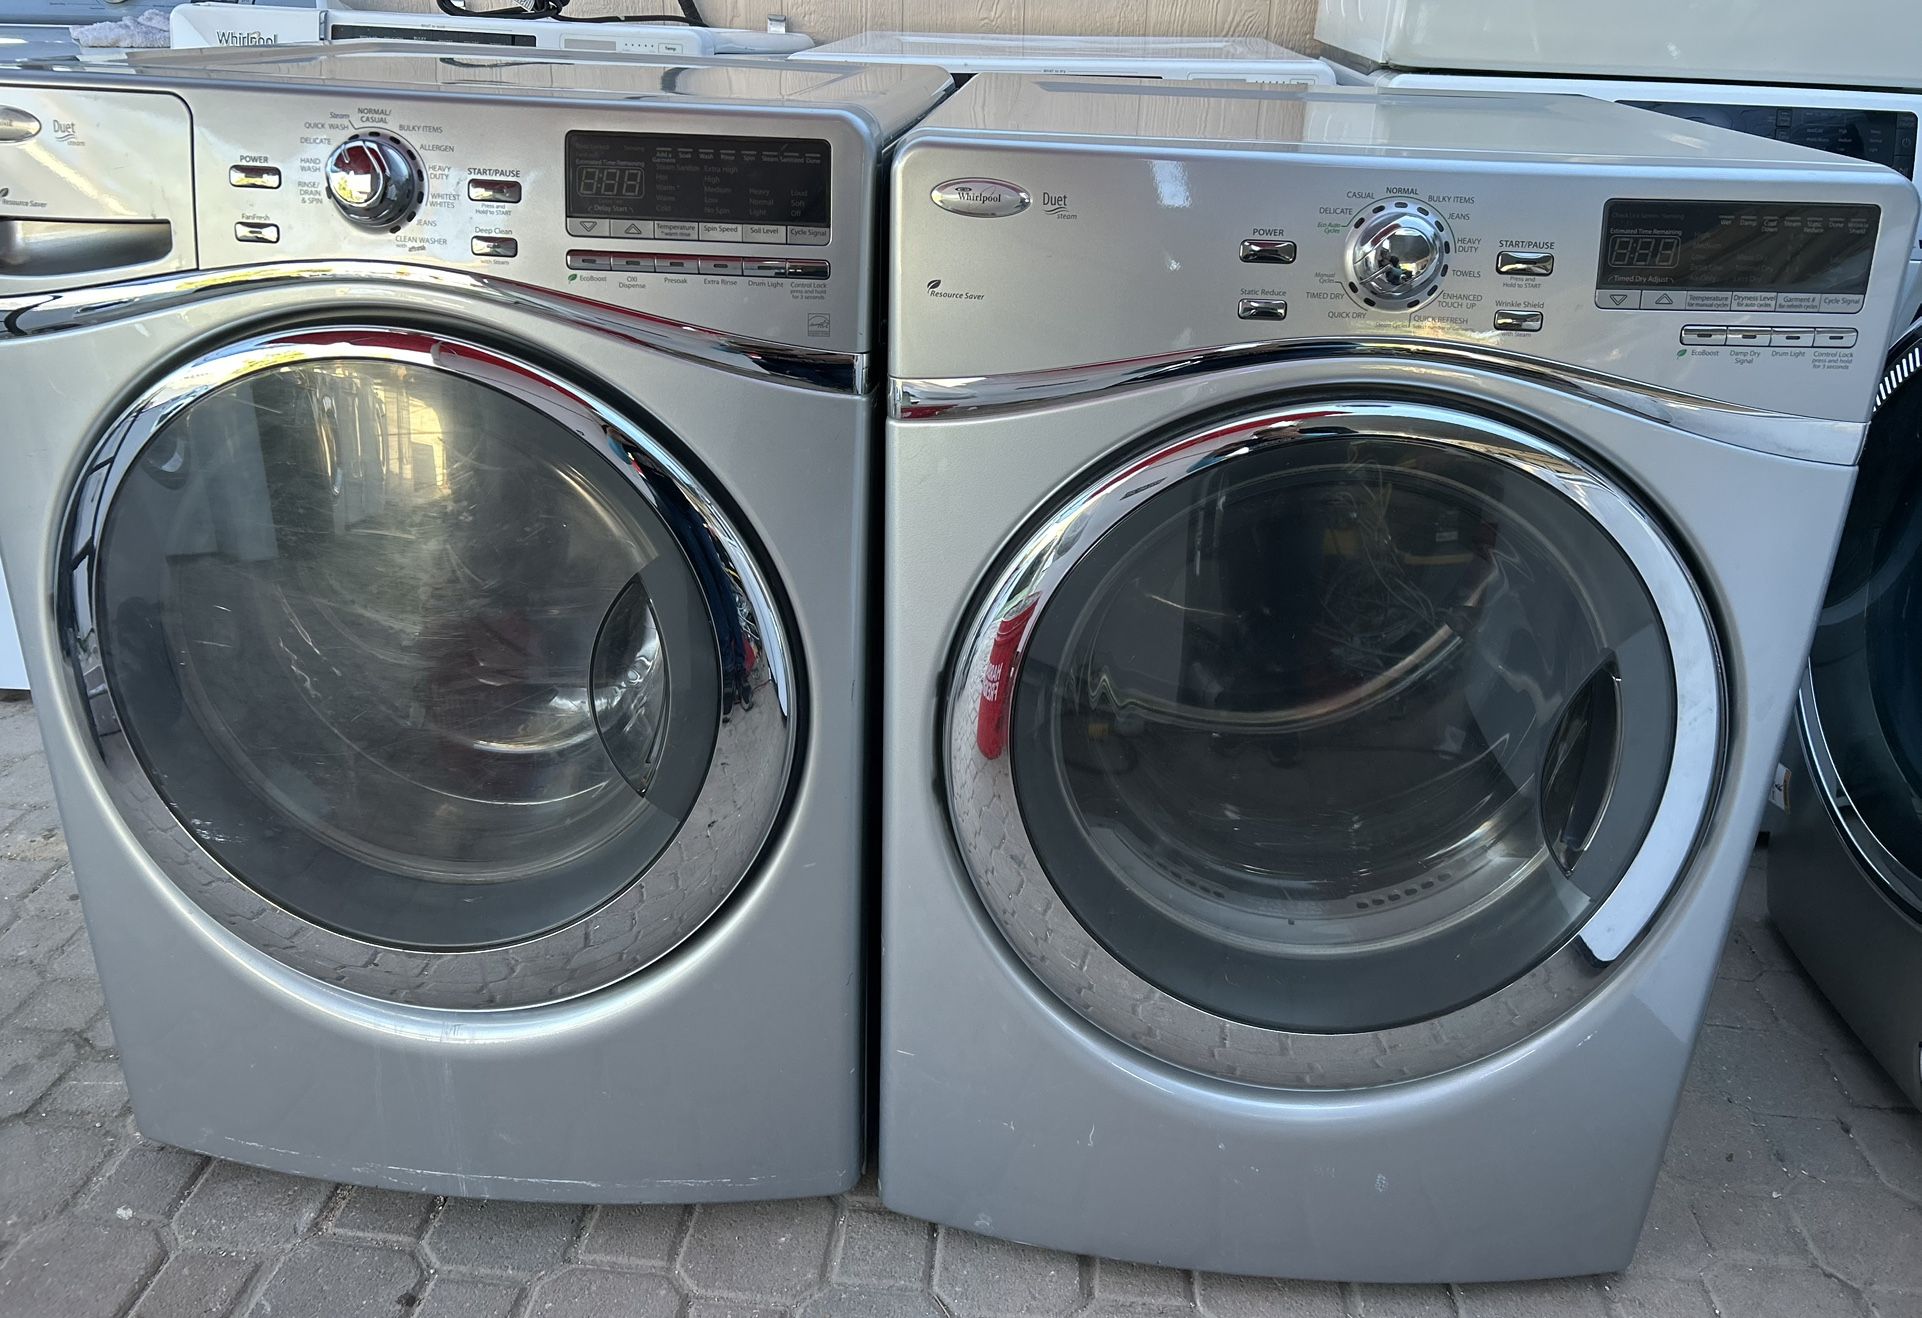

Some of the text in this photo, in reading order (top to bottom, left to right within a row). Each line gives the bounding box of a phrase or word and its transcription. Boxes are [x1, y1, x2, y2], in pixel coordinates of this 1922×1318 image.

[216, 31, 277, 46] Whirlpool
[358, 108, 392, 116] NORMAL/
[360, 116, 388, 124] CASUAL
[53, 119, 76, 134] Duet
[304, 122, 326, 130] QUICK
[399, 124, 443, 134] BULKY ITEMS
[300, 137, 332, 145] DELICATE
[420, 143, 455, 153] ALLERGEN
[239, 154, 269, 164] POWER
[300, 165, 321, 173] WASH
[428, 164, 452, 173] HEAVY
[467, 167, 521, 178] START/PAUSE
[430, 173, 450, 181] DUTY
[299, 188, 321, 197] DRAIN
[1346, 191, 1375, 200] CASUAL
[1385, 186, 1419, 196] NORMAL
[308, 197, 324, 205] SPIN
[431, 192, 461, 201] WHITEST
[957, 192, 1002, 204] Whirlpool
[1042, 191, 1068, 207] Duet
[1427, 195, 1475, 204] BULKY ITEMS
[30, 200, 47, 208] Saver
[429, 201, 456, 209] WHITES
[1319, 207, 1353, 216] DELICATE
[1447, 212, 1470, 221] JEANS
[416, 219, 438, 227] JEANS
[656, 223, 696, 232] Temperature
[474, 226, 513, 235] Deep Clean
[703, 225, 738, 235] Spin Speed
[763, 227, 779, 235] Level
[790, 229, 827, 239] Cycle Signal
[1252, 228, 1285, 237] POWER
[395, 235, 448, 246] CLEAN WASHER
[1456, 238, 1482, 246] HEAVY
[1498, 239, 1555, 250] START/PAUSE
[1457, 246, 1479, 254] DUTY
[579, 274, 607, 283] EcoBoost
[1452, 269, 1481, 279] TOWELS
[664, 276, 688, 284] Presoak
[1635, 275, 1647, 284] Dry
[619, 282, 647, 290] Dispense
[768, 280, 784, 289] Light
[790, 281, 827, 290] Control Lock
[930, 289, 985, 301] Resource Saver
[1240, 288, 1287, 297] Static Reduce
[1305, 291, 1345, 300] TIMED DRY
[1442, 292, 1483, 302] ENHANCED
[1688, 294, 1729, 303] Temperature
[1733, 294, 1777, 303] Dryness Level
[1783, 296, 1810, 304] Garment
[1823, 296, 1861, 306] Cycle Signal
[1437, 301, 1477, 310] TOUCH UP
[1495, 300, 1545, 309] Wrinkle Shield
[1327, 310, 1367, 320] QUICK DRY
[1413, 315, 1469, 325] QUICK REFRESH
[1690, 349, 1720, 357] EcoBoost
[1729, 350, 1761, 359] Damp Dry
[1790, 350, 1806, 359] Light
[1813, 350, 1854, 359] Control Lock
[1734, 357, 1754, 366] Signal
